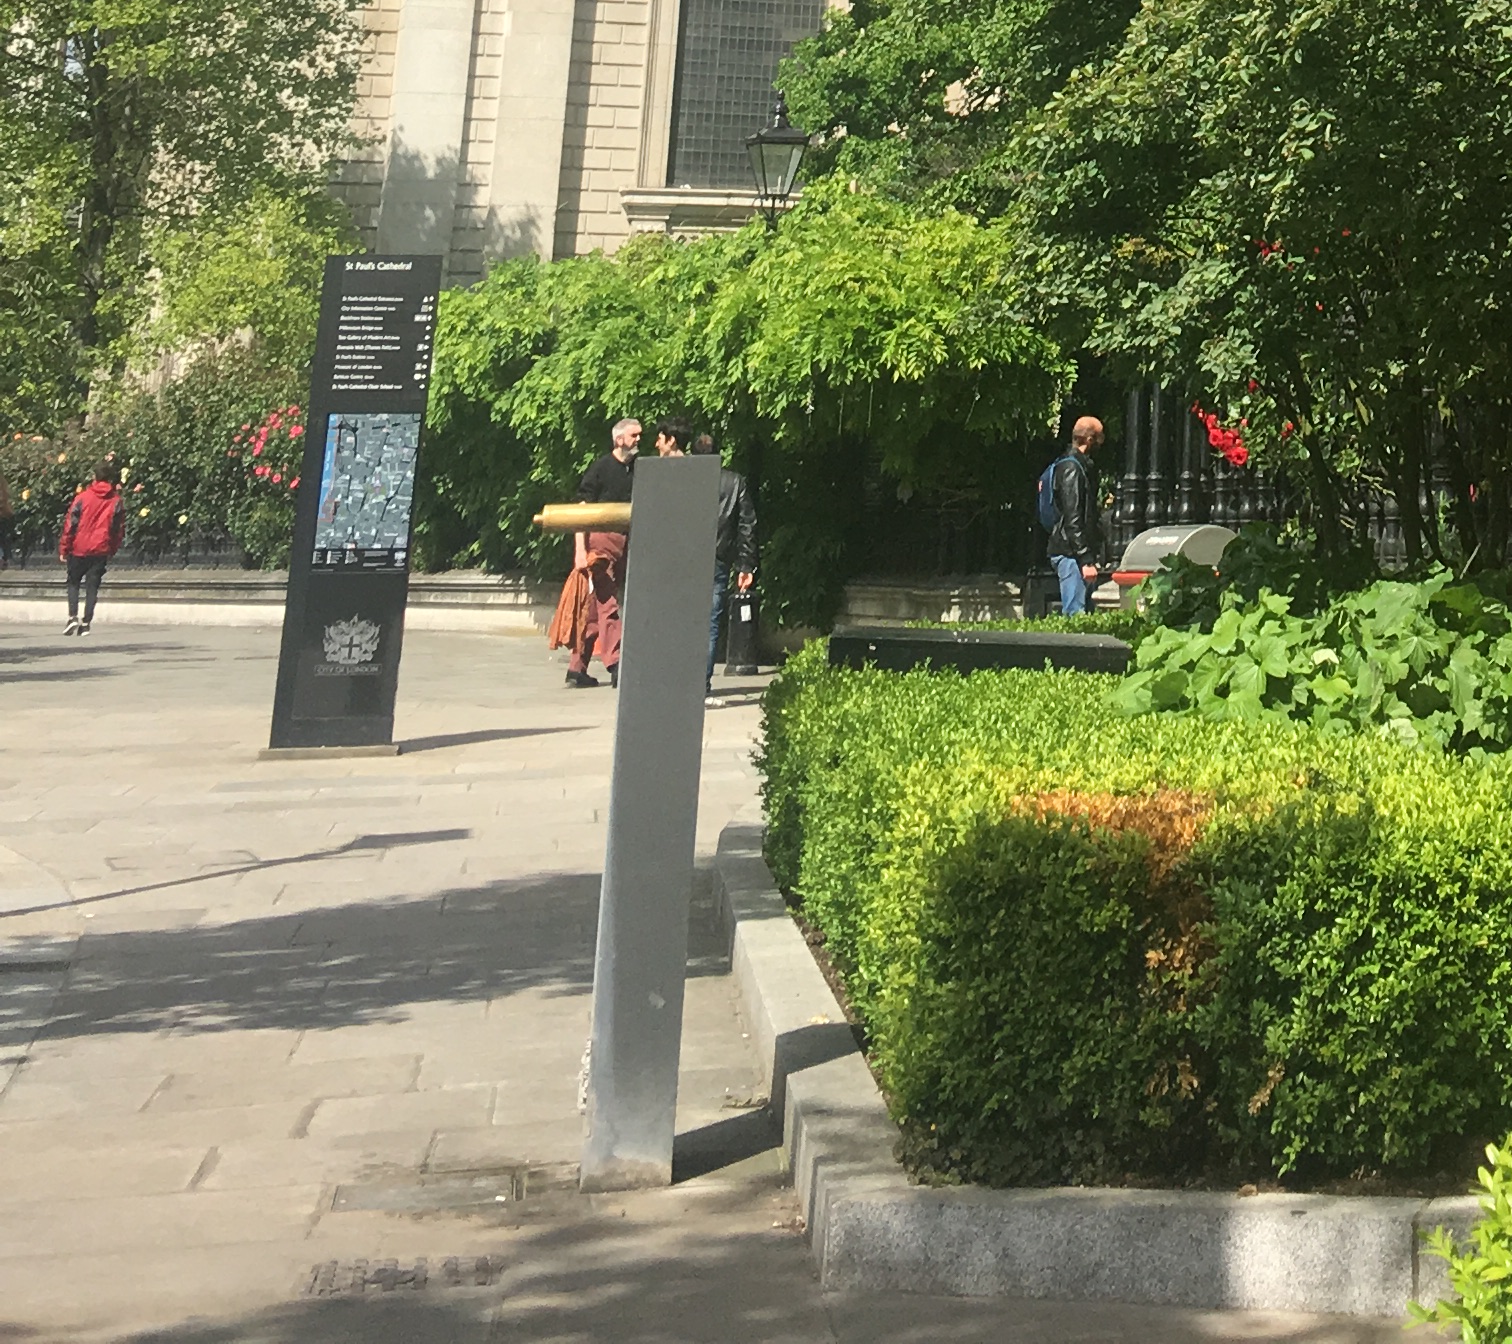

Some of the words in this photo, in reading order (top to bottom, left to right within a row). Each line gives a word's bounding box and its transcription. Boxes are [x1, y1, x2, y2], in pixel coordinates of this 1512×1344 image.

[345, 261, 353, 270] St
[355, 261, 375, 270] Paul's
[376, 261, 412, 271] Cathedral
